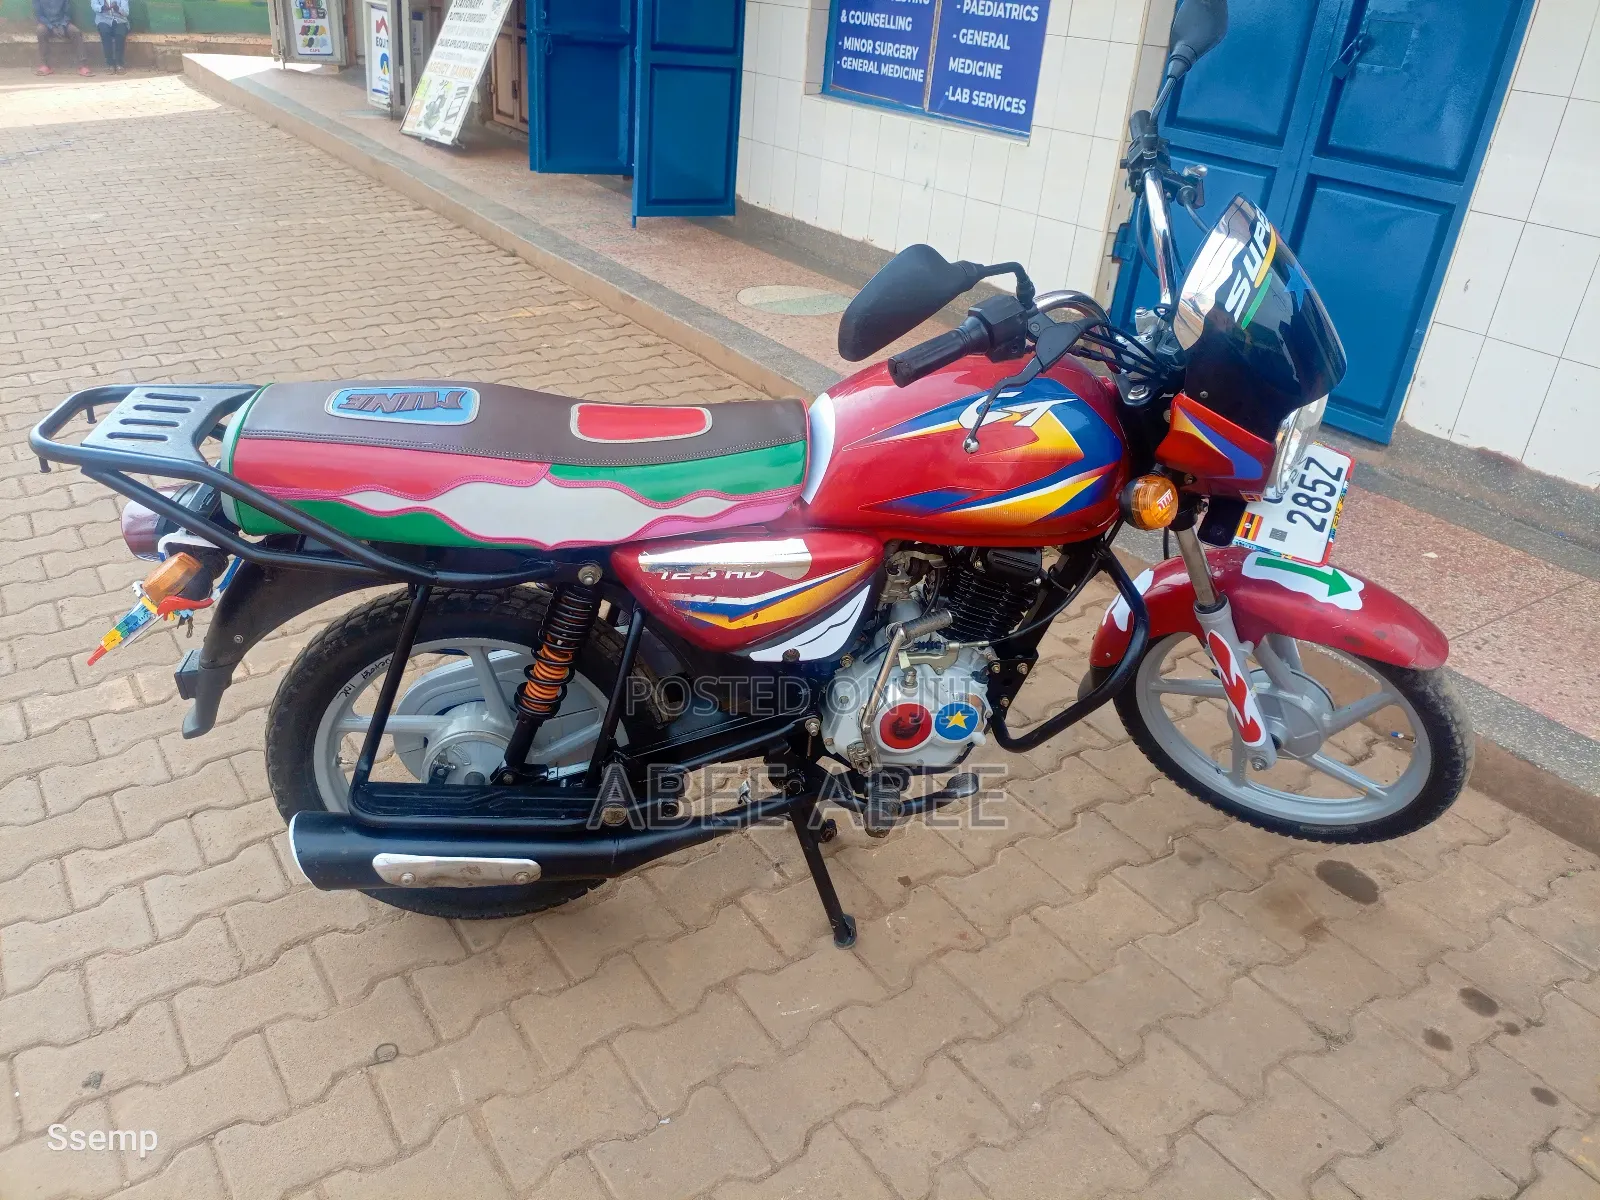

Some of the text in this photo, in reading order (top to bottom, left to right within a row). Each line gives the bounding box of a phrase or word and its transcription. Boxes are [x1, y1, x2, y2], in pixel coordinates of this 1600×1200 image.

[840, 9, 913, 31] & COUNSELLING
[962, 0, 1040, 22] PAEDIATRICS
[843, 36, 919, 60] MINOR SURGERY
[959, 28, 1011, 50] GENERAL
[841, 56, 925, 82] GENERAL MEDICINE
[948, 56, 1004, 80] MEDICINE
[971, 90, 1027, 115] SERVICES
